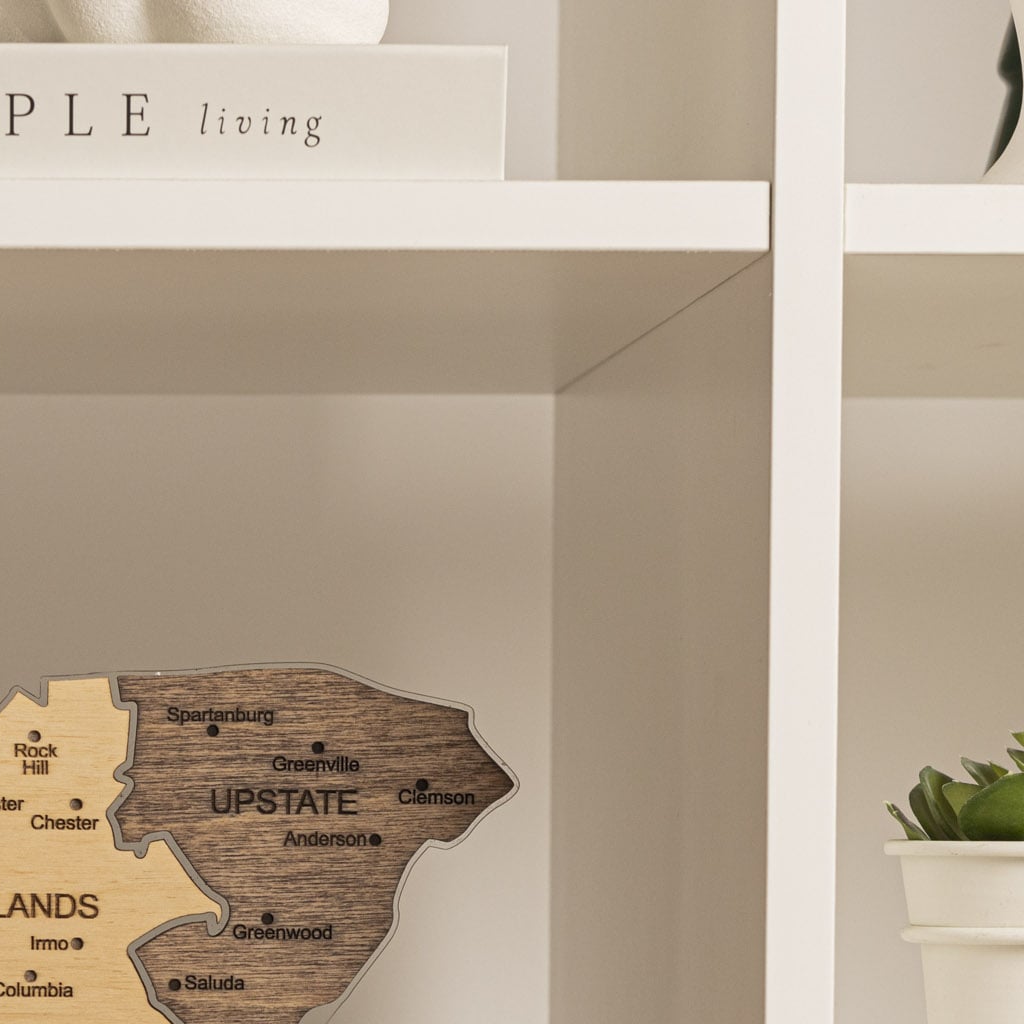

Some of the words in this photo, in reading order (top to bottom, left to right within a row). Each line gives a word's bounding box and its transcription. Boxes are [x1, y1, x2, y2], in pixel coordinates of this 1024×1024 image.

[198, 103, 324, 148] living
[167, 707, 274, 726] Spartanburg
[14, 743, 58, 758] Rock
[22, 760, 49, 775] Hill
[272, 756, 360, 773] Greenville
[210, 789, 358, 815] UPSTATE
[398, 790, 475, 806] Clemson
[30, 814, 99, 830] Chester
[284, 831, 367, 848] Anderson
[232, 924, 333, 941] Greenwood
[30, 936, 68, 951] Irmo
[184, 975, 245, 991] Saluda
